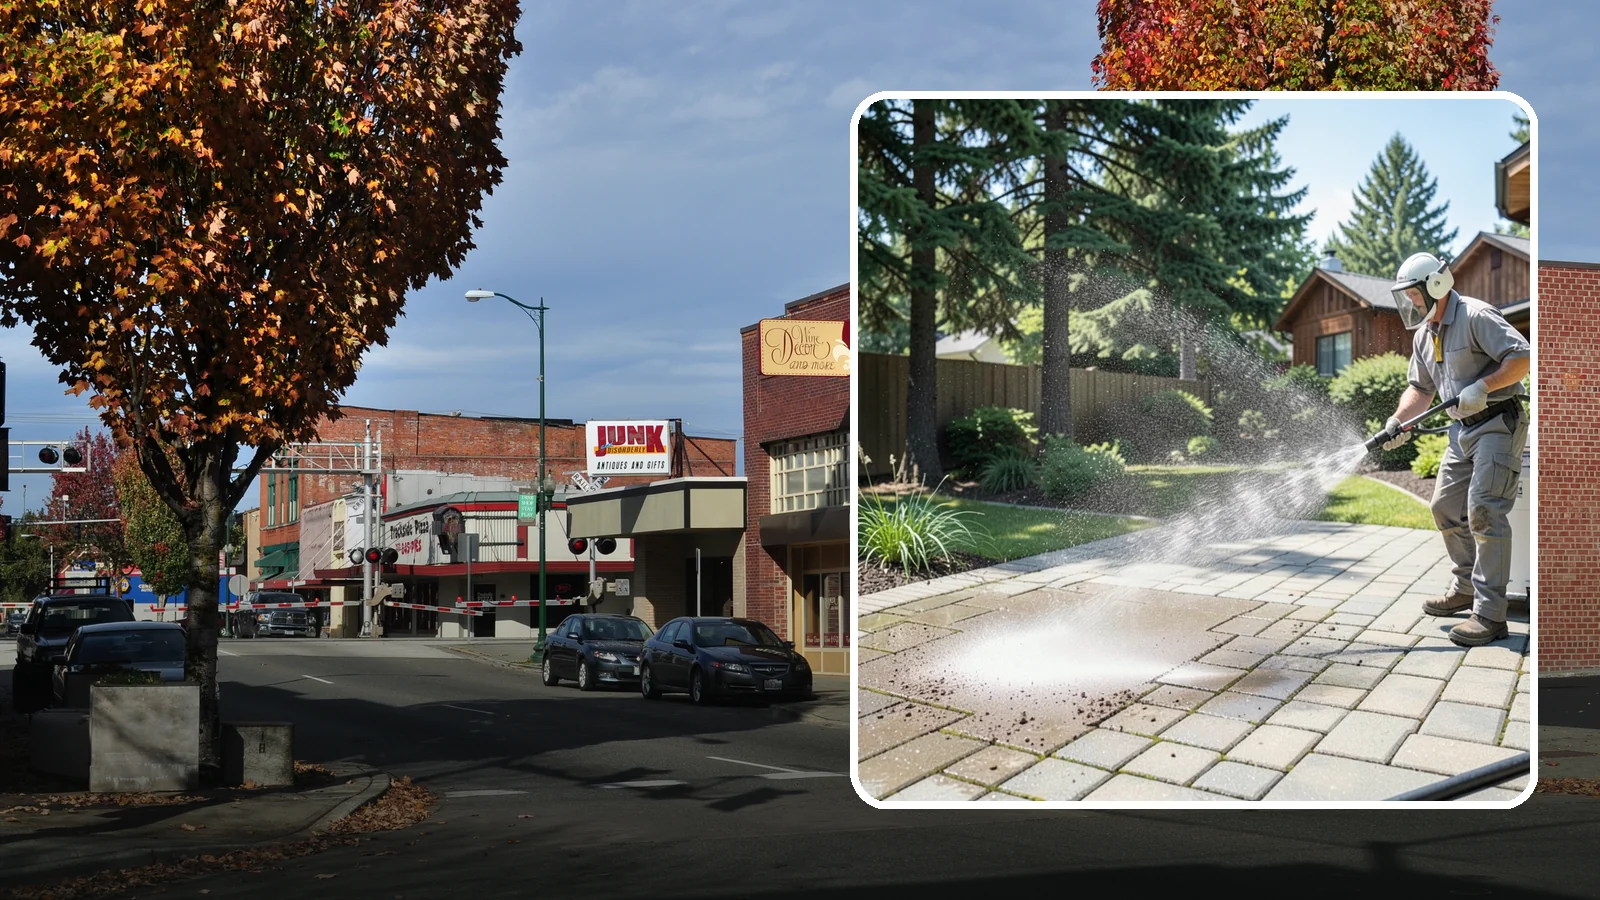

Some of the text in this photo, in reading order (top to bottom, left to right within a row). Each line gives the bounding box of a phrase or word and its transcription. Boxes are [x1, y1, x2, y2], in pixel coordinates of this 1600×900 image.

[595, 425, 665, 457] JUNK
[607, 446, 646, 454] DISORDERLY
[596, 460, 666, 470] ANTIQUES AND GIFTS
